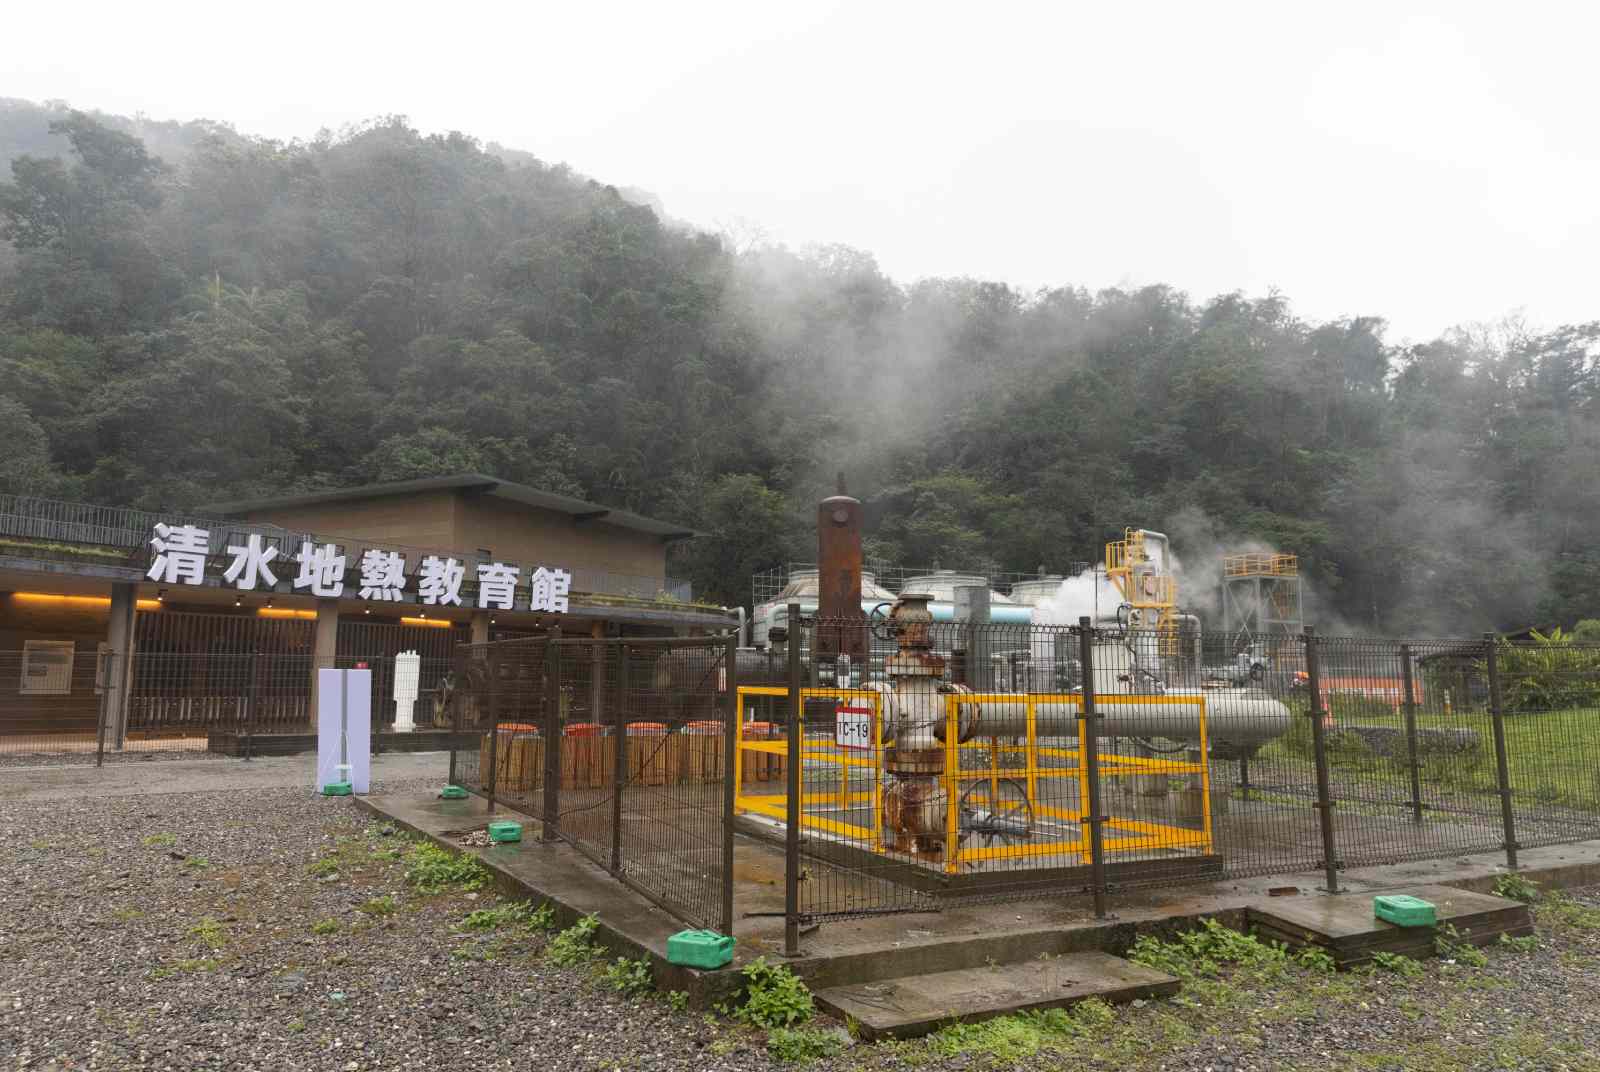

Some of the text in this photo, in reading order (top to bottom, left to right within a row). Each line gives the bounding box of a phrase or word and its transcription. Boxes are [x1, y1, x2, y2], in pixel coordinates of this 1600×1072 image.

[147, 522, 571, 613] 清水地熱教育館
